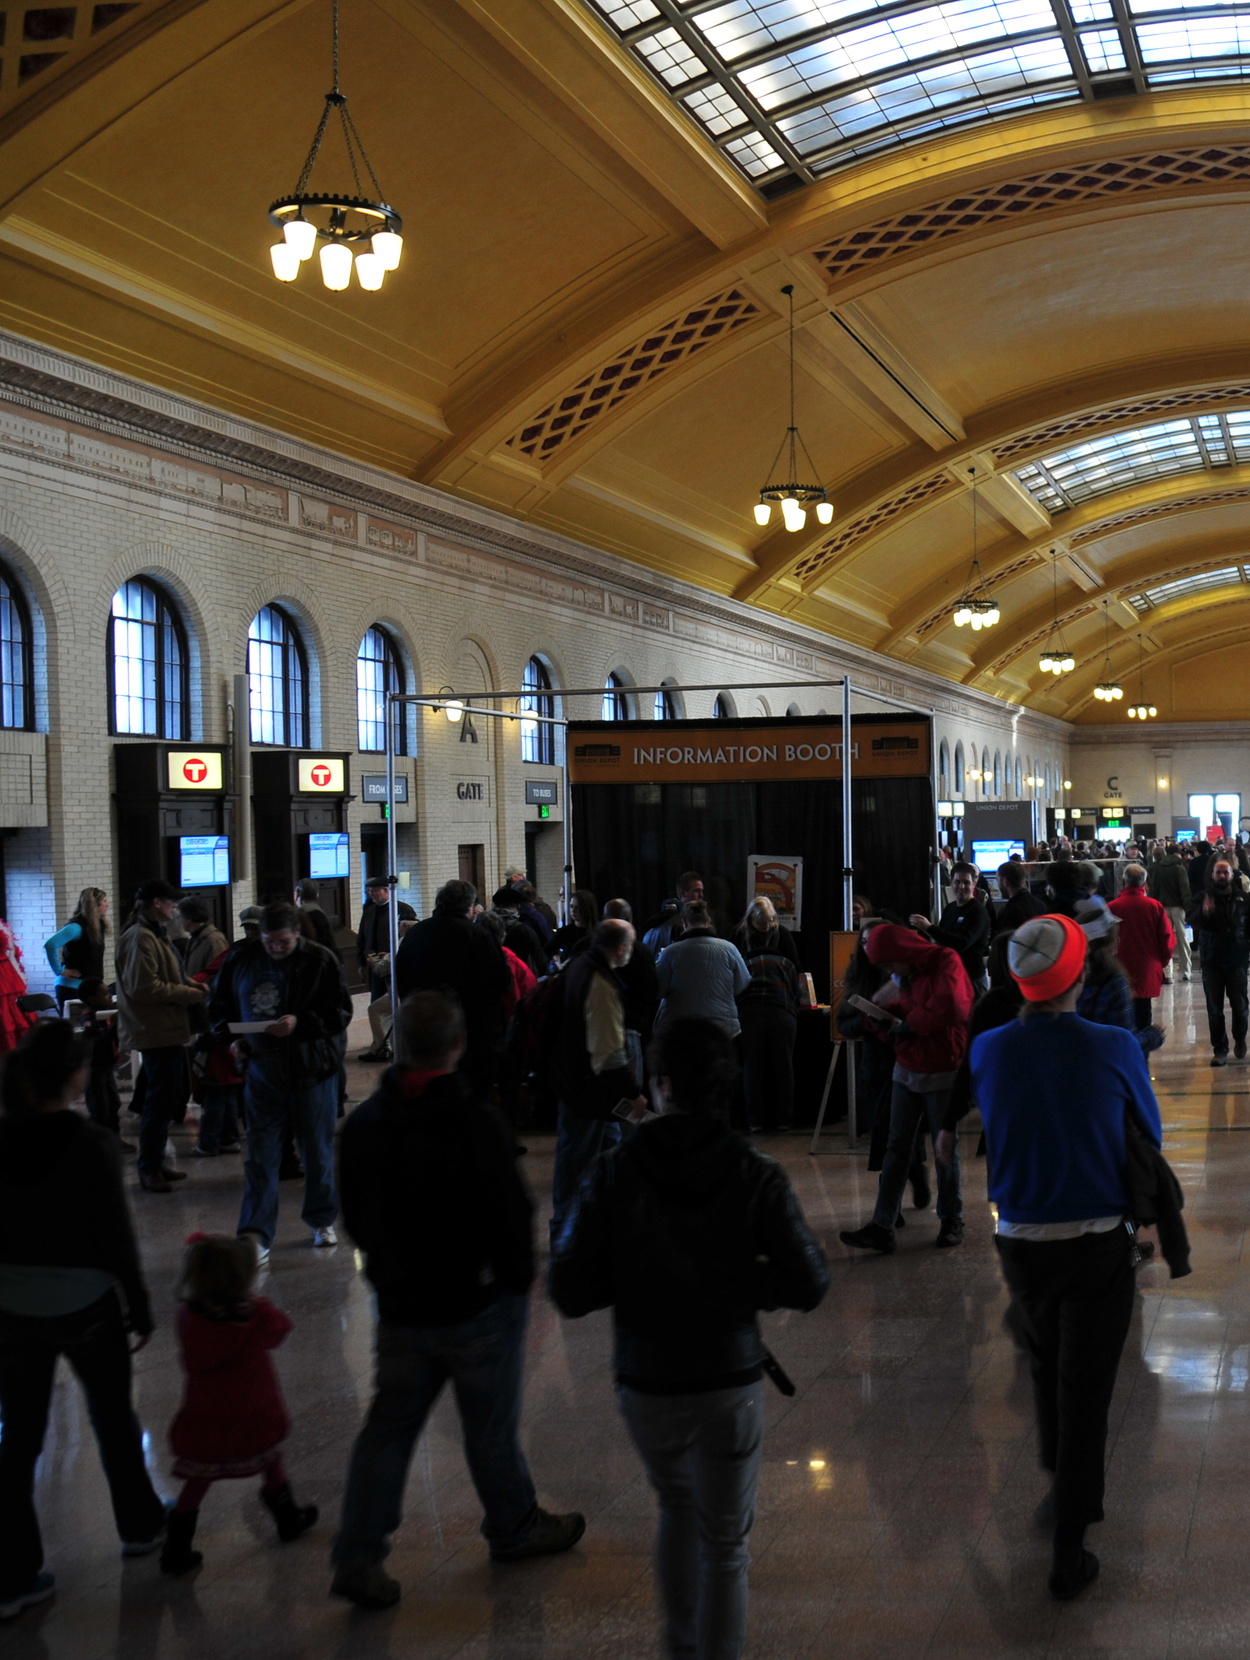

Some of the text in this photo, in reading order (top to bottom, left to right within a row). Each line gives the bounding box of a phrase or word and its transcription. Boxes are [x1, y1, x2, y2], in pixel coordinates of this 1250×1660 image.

[460, 699, 479, 744] A
[633, 742, 861, 765] INFORMATION BOOTH
[369, 784, 386, 794] FROM
[457, 782, 484, 800] GATE
[1107, 776, 1119, 791] C
[533, 788, 539, 797] TO
